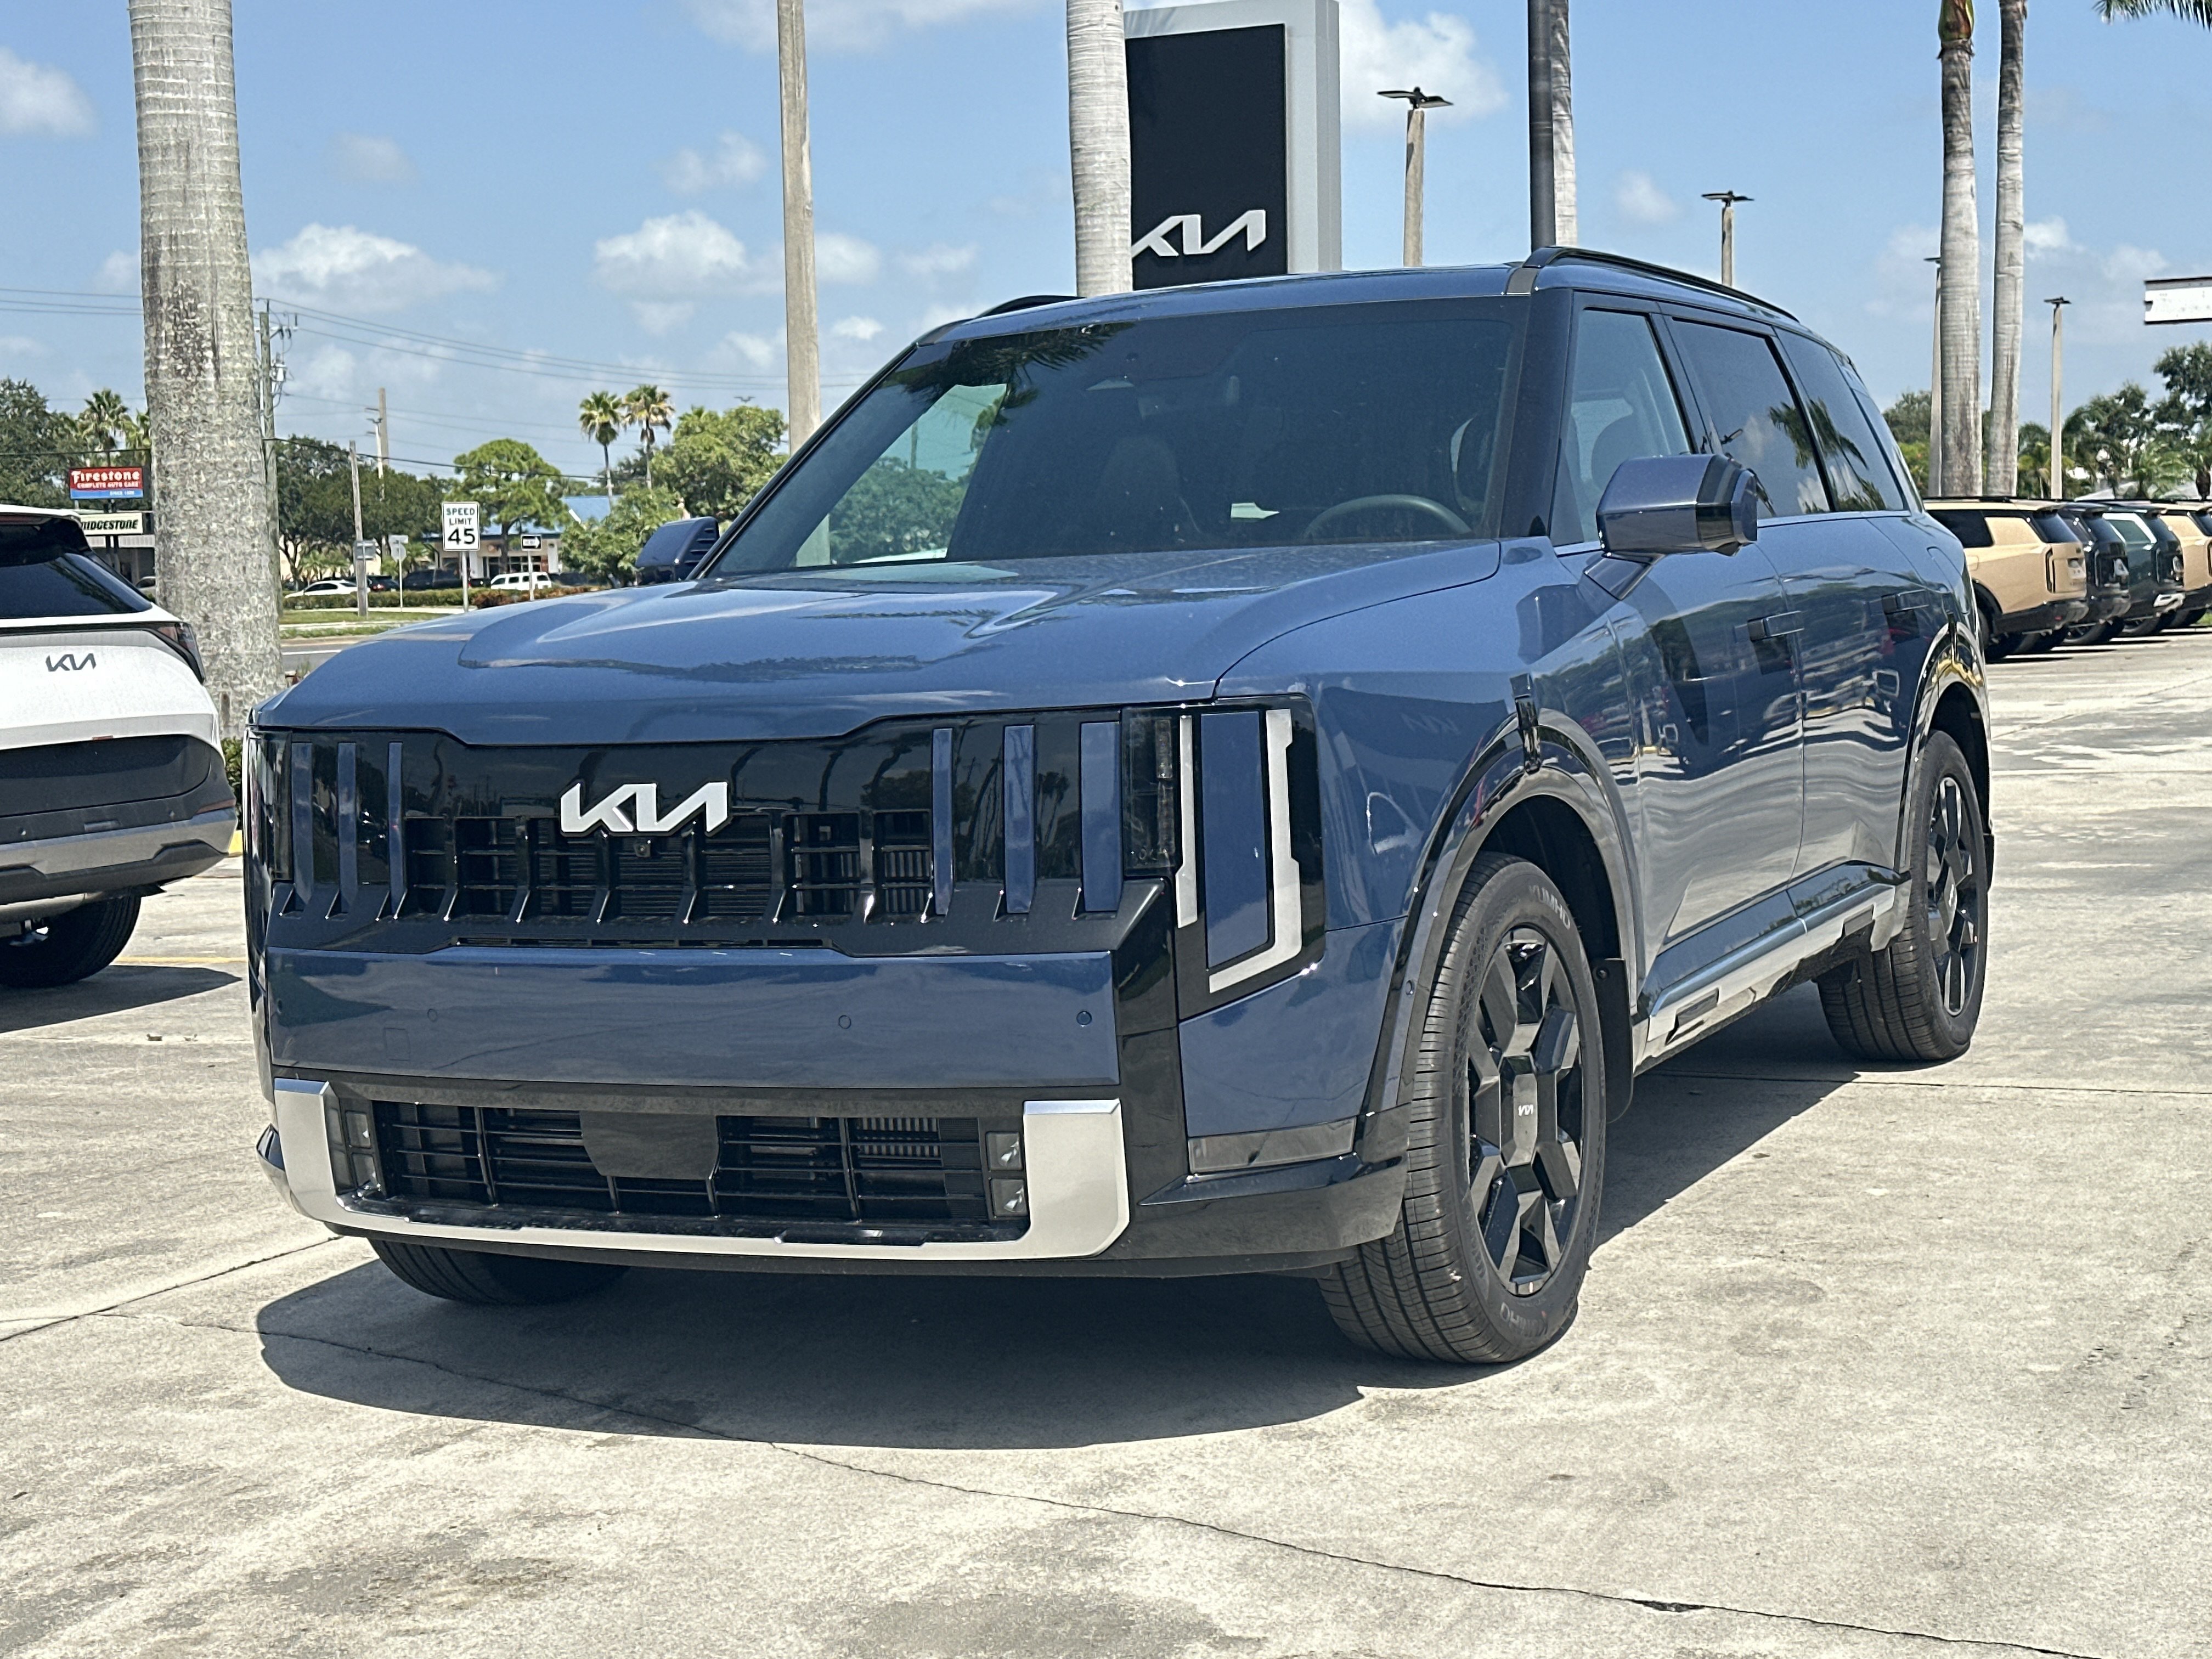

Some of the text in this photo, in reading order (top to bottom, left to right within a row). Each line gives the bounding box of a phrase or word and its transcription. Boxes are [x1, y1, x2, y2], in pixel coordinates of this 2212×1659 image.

[1131, 209, 1266, 257] KIA
[71, 471, 139, 484] Firestone
[446, 507, 475, 516] SPEED
[449, 517, 472, 526] LIMIT
[448, 528, 475, 545] 45
[46, 653, 97, 672] KIA
[561, 782, 727, 832] KIA
